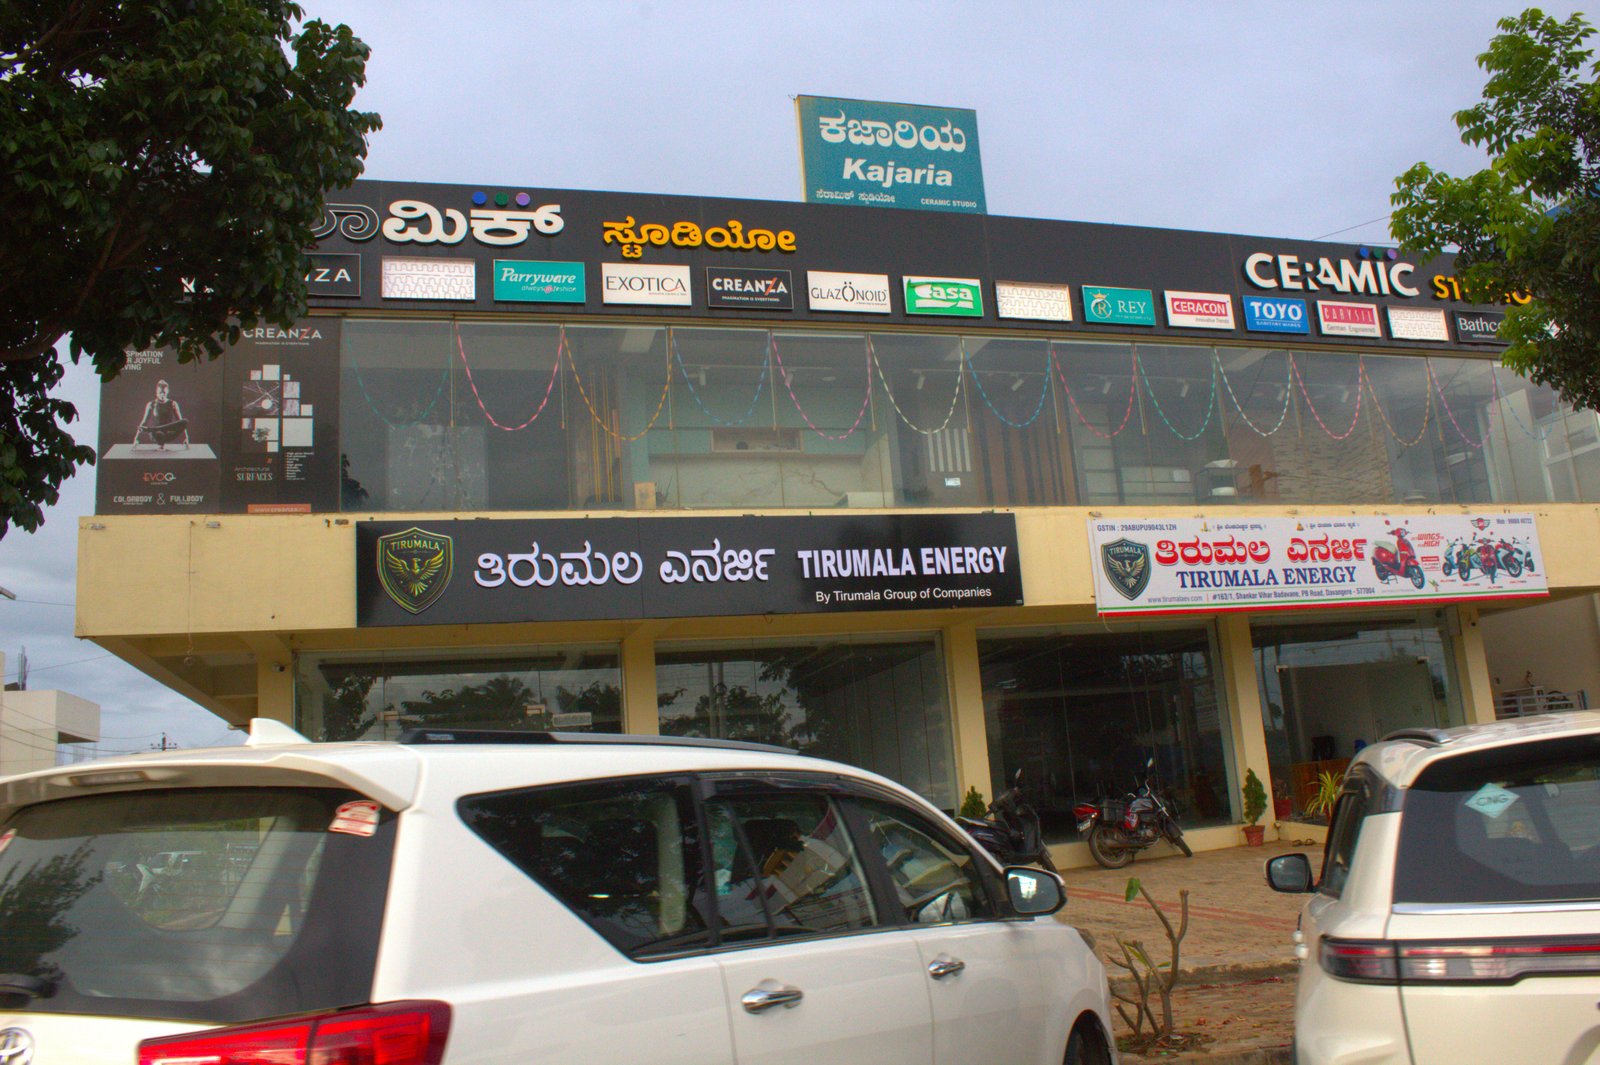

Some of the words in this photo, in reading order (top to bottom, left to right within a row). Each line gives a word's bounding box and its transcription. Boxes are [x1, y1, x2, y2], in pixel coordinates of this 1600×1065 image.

[819, 109, 966, 152] ಕಜಾರಿಯ
[843, 158, 952, 187] Kajaria
[921, 198, 951, 206] CERAMIC
[952, 200, 977, 208] STUDIO
[501, 267, 576, 285] Parryware
[1245, 252, 1420, 297] CERAMIC
[606, 276, 687, 293] EXOTICA
[712, 277, 788, 295] CREANZA
[1118, 300, 1147, 314] REY
[1173, 301, 1226, 315] CERACON
[1250, 302, 1303, 321] TOYO
[1324, 307, 1373, 322] CARYSIL
[242, 327, 322, 340] CREANZA
[1327, 323, 1348, 331] German
[1097, 524, 1116, 532] GSTIN
[390, 540, 440, 551] TIRUMALA
[1155, 534, 1271, 566] ತಿರುಮಲ
[474, 541, 643, 588] ತಿರುಮಲ
[798, 548, 917, 578] TIRUMALA
[922, 546, 1007, 576] ENERGY
[1176, 568, 1280, 588] TIRUMALA
[1282, 566, 1357, 586] ENERGY
[815, 590, 831, 604] By
[833, 589, 880, 601] Tirumala
[883, 589, 917, 604] Group
[919, 588, 930, 599] of
[933, 586, 992, 601] Companies
[1236, 591, 1257, 600] Shankar
